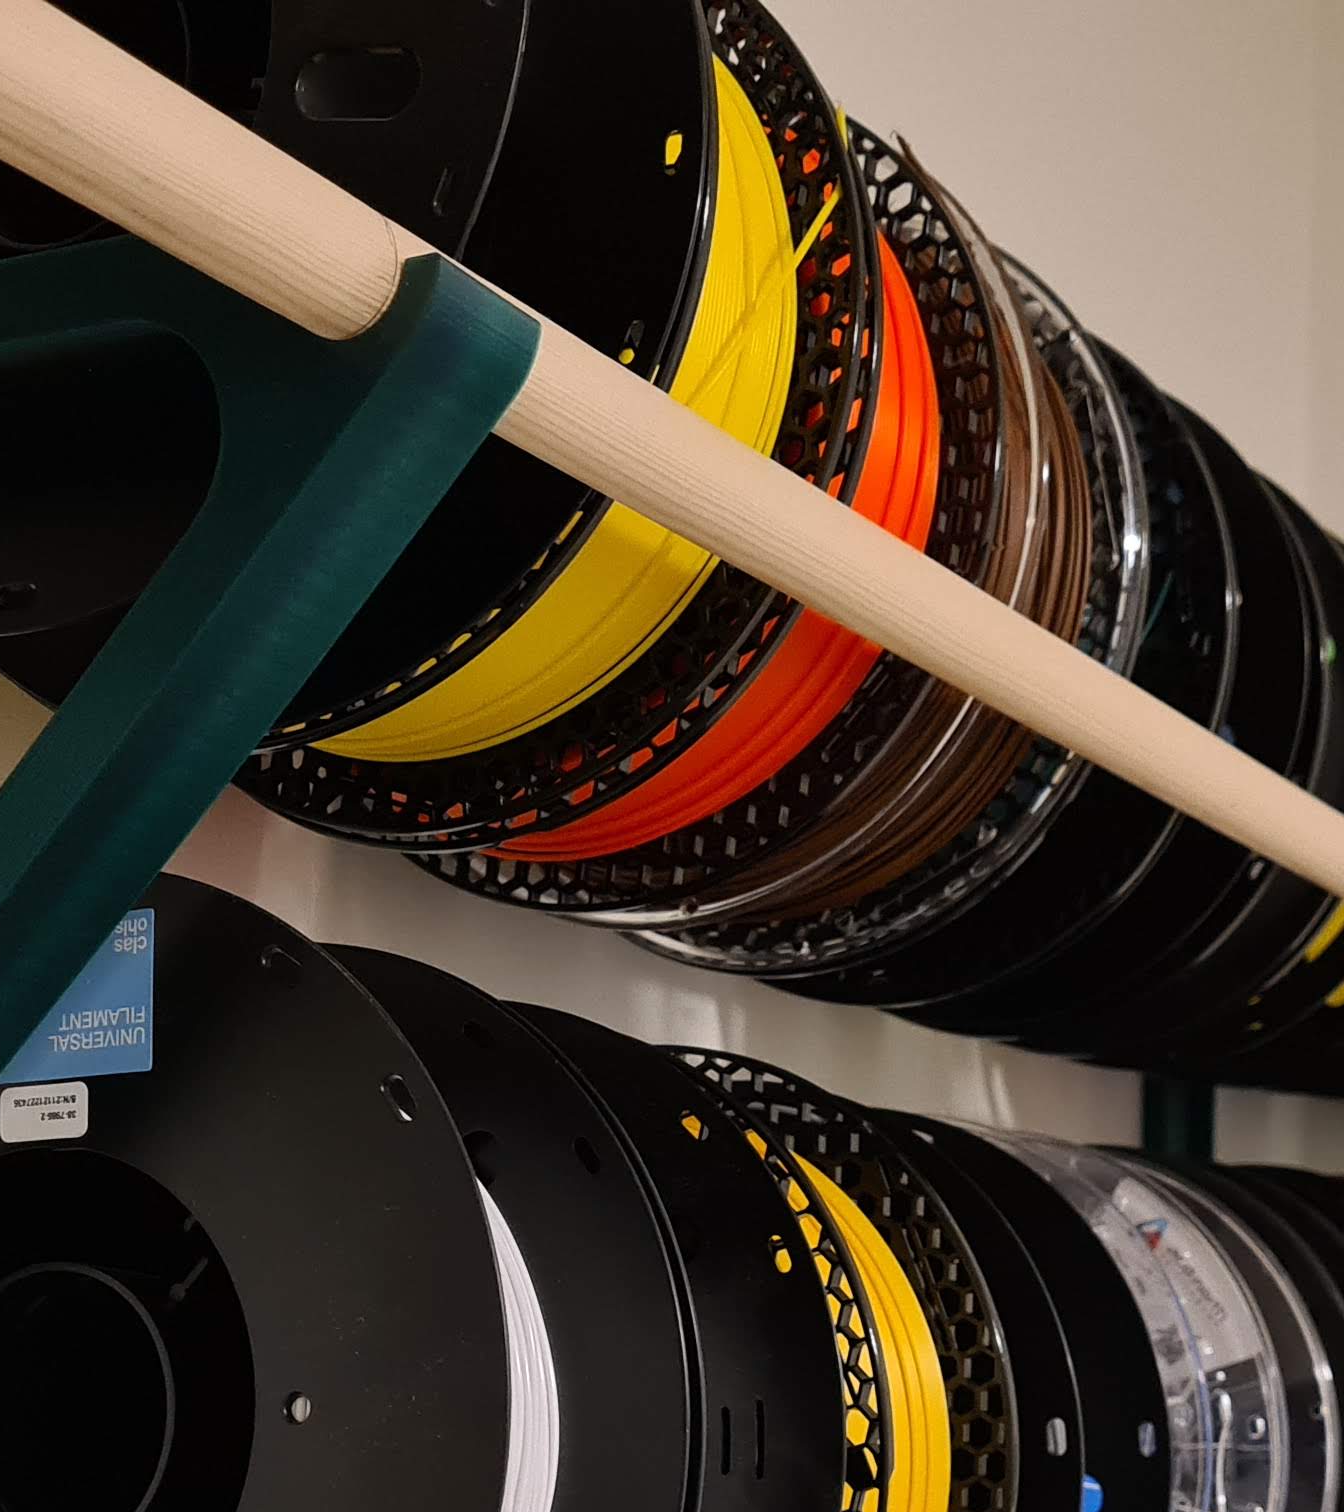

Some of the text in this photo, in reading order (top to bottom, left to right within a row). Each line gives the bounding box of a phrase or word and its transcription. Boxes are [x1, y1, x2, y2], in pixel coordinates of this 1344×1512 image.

[114, 936, 147, 954] clas
[59, 1006, 145, 1031] FILAMENT
[48, 1027, 145, 1052] UNIVERSAL
